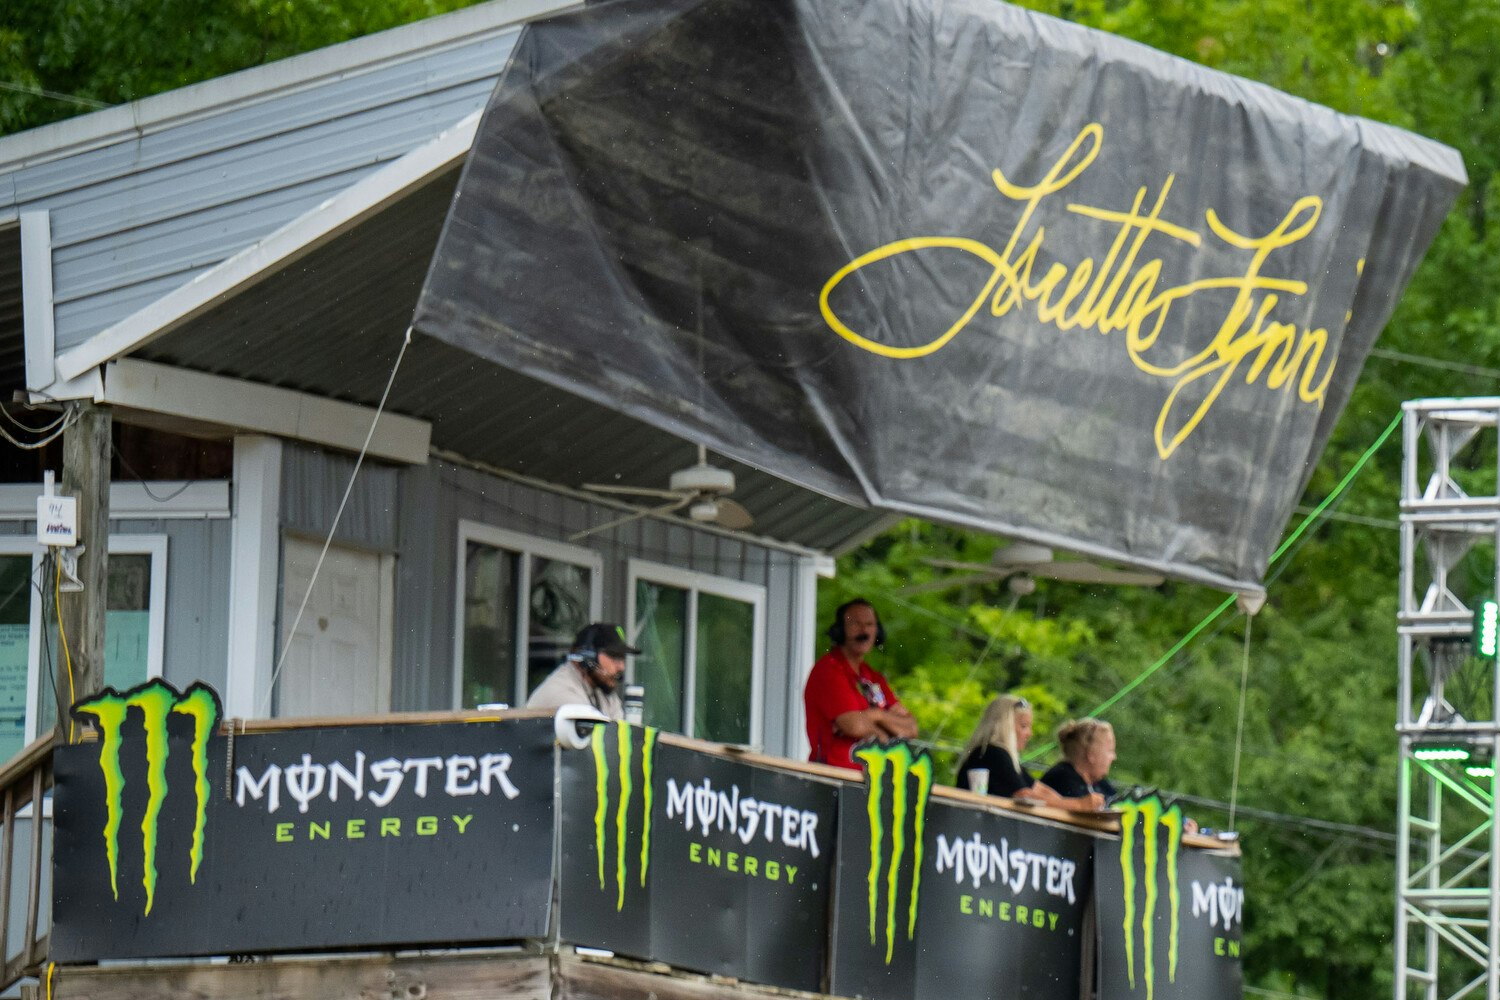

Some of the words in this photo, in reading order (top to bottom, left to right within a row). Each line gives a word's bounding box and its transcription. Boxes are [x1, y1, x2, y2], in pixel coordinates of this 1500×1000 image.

[820, 122, 1202, 358] Loretta
[236, 751, 519, 813] MONSTER
[276, 814, 473, 843] ENERGY
[666, 777, 820, 858] MONSTER
[689, 843, 799, 885] ENERGY
[936, 832, 1077, 904] MONSTER
[960, 895, 1059, 931] ENERGY
